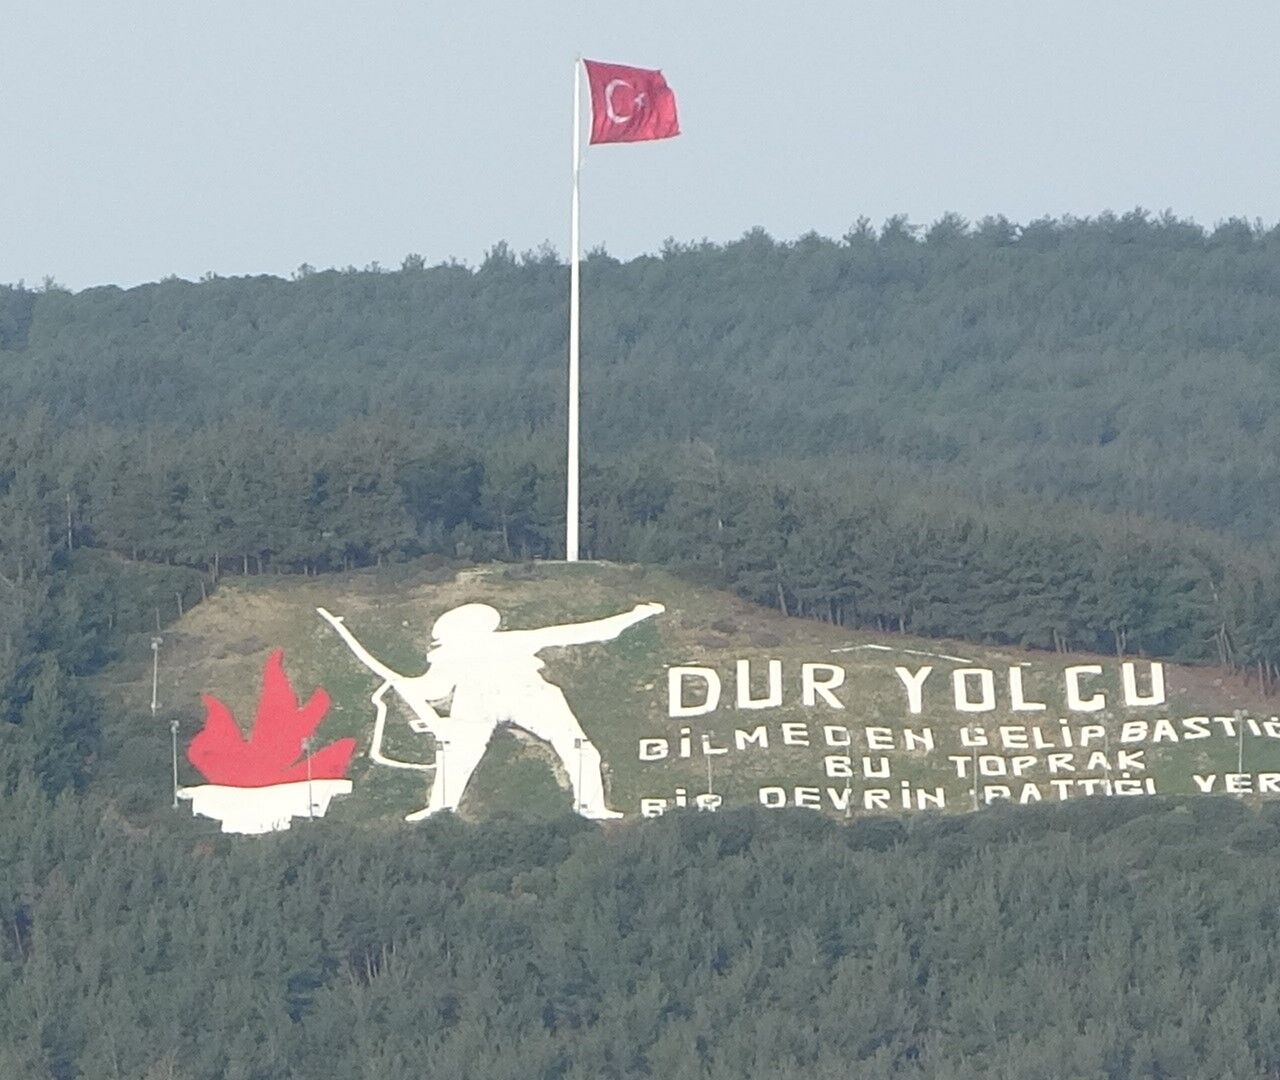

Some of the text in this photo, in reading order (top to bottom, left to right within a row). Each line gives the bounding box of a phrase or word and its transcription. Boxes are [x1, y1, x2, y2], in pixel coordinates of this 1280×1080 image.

[667, 659, 1166, 718] DUR YOLCU
[824, 750, 1145, 779] BU TOPRAK
